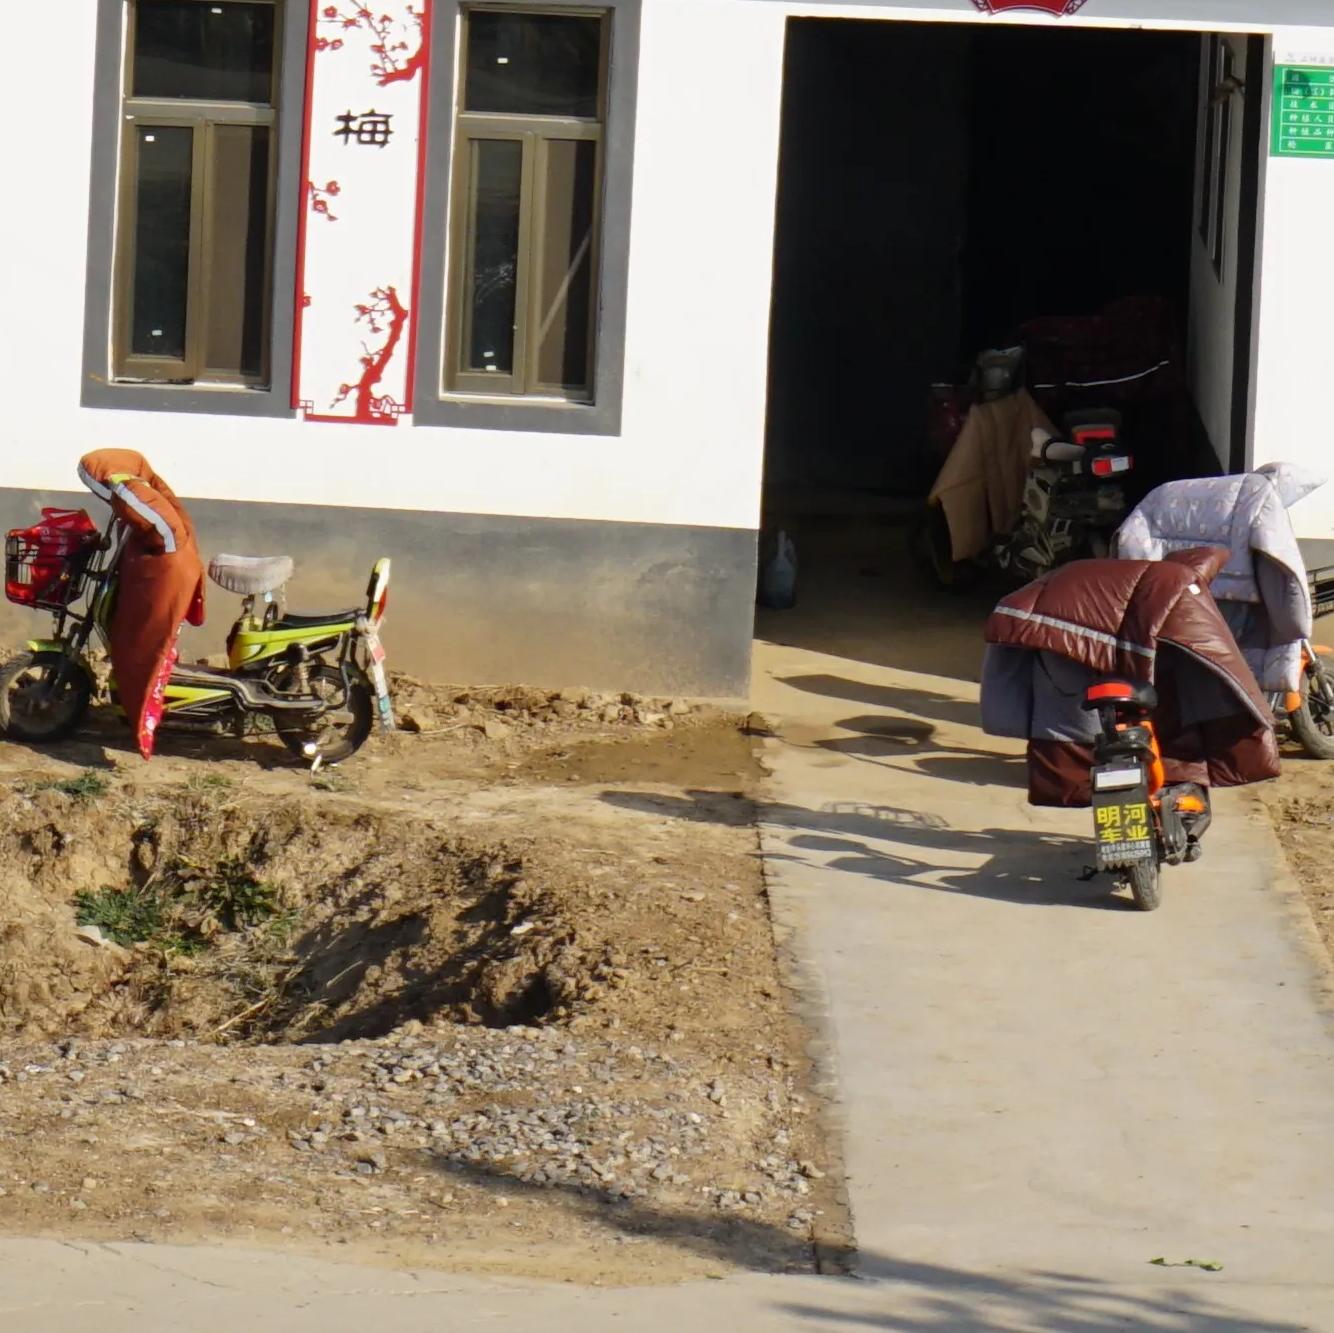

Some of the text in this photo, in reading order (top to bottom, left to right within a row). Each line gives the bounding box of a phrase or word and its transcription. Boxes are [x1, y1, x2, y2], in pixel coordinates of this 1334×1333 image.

[333, 108, 395, 149] 梅
[1097, 803, 1147, 827] 明河
[1099, 825, 1150, 843] 车业
